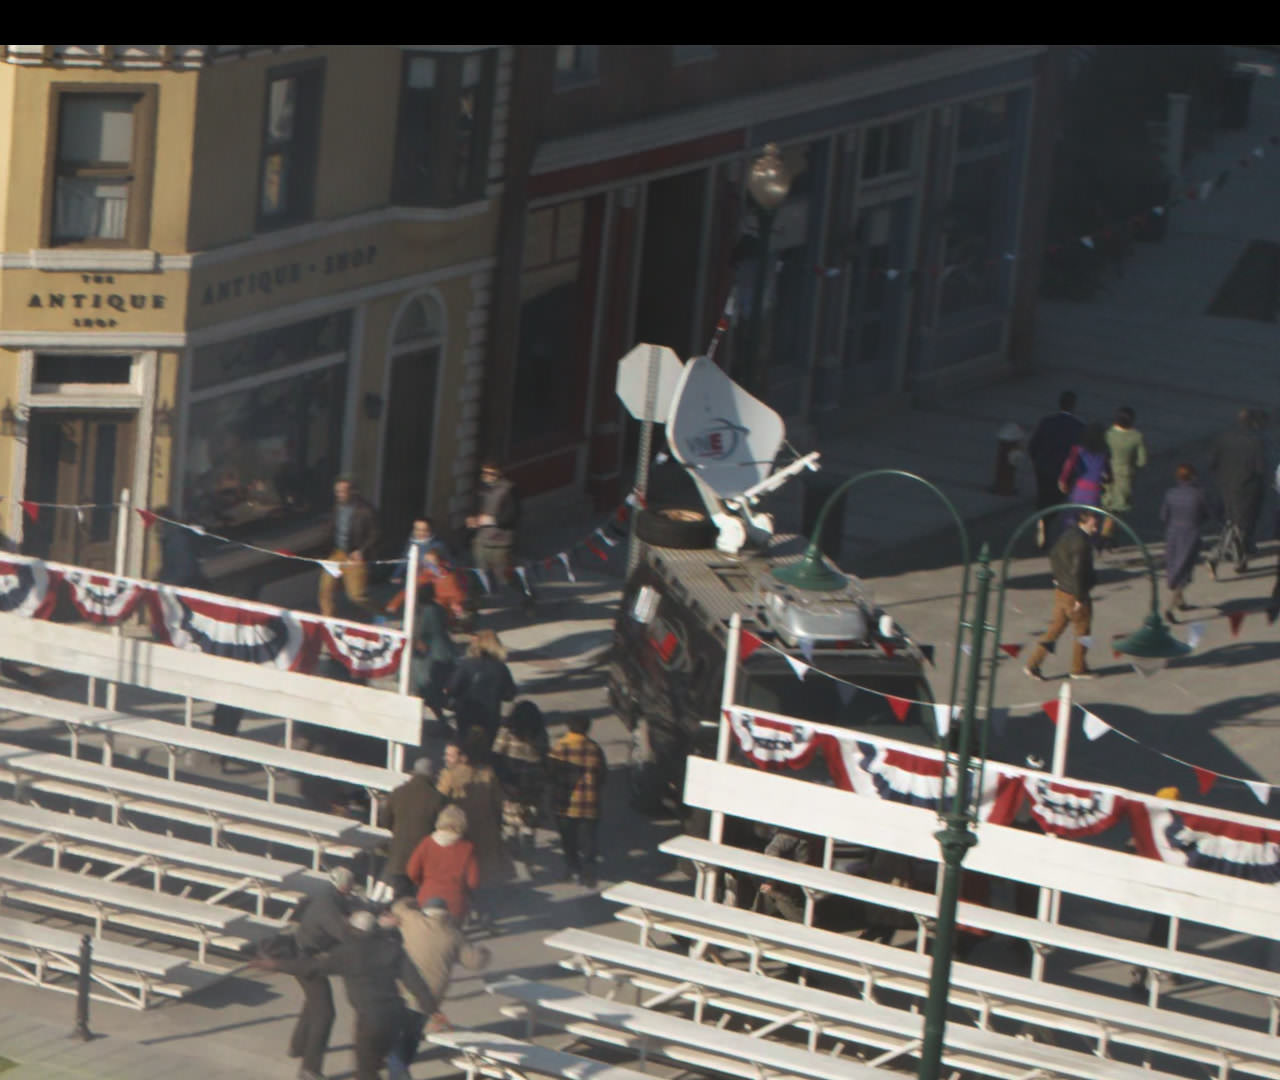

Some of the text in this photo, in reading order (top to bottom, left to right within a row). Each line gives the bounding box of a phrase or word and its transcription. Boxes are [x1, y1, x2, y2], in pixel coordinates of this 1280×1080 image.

[81, 274, 116, 285] THE
[199, 244, 378, 306] ANTIQUE SHOP
[27, 293, 167, 312] ANTIQUE
